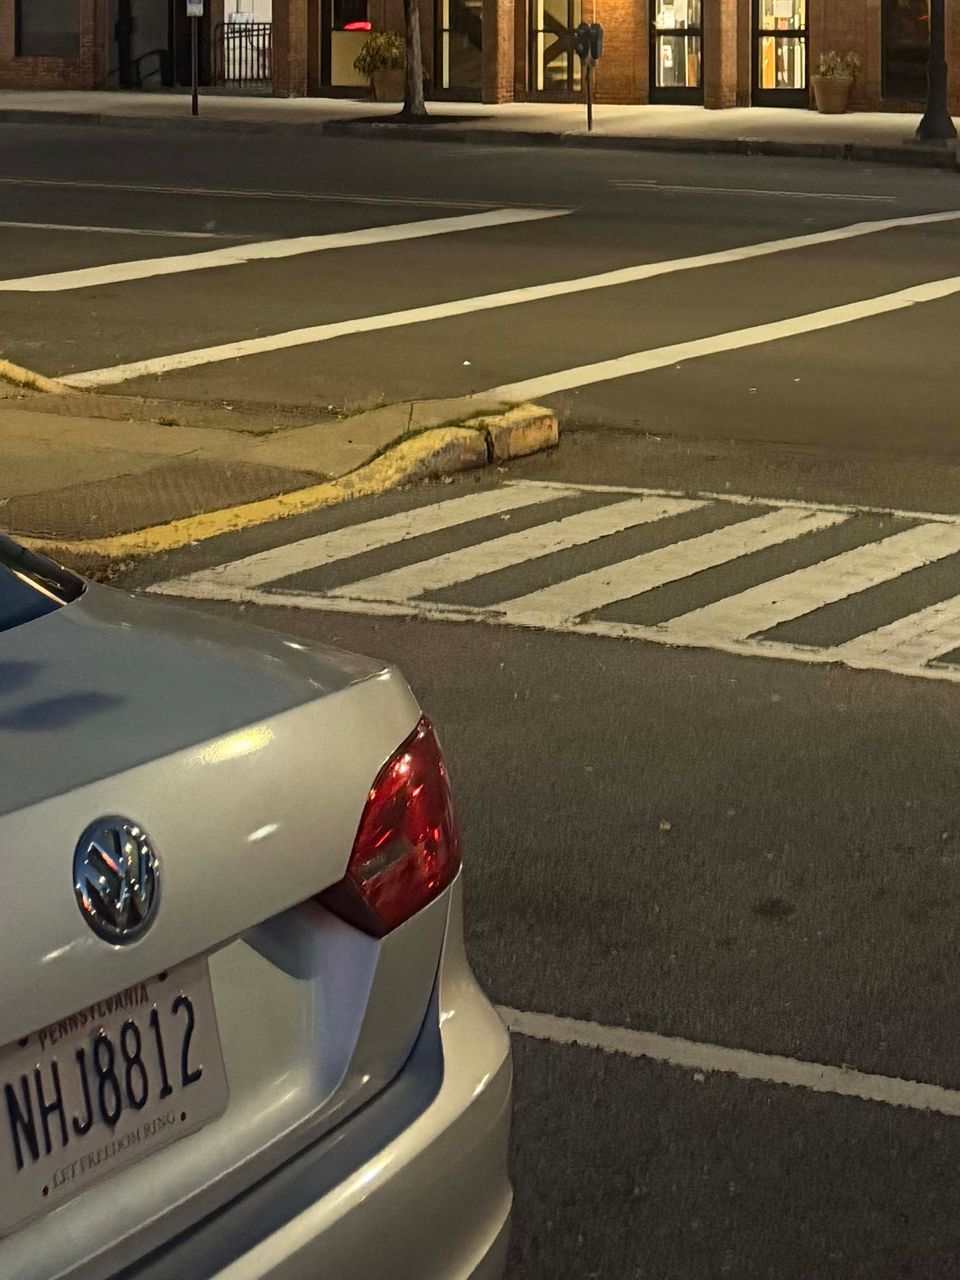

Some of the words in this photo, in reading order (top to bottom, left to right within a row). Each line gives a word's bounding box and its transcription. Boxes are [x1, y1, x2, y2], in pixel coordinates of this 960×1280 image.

[38, 984, 150, 1050] PENNSYLVANIA
[4, 991, 203, 1172] NHJ8812
[53, 1159, 78, 1188] LET
[143, 1112, 176, 1139] RING
